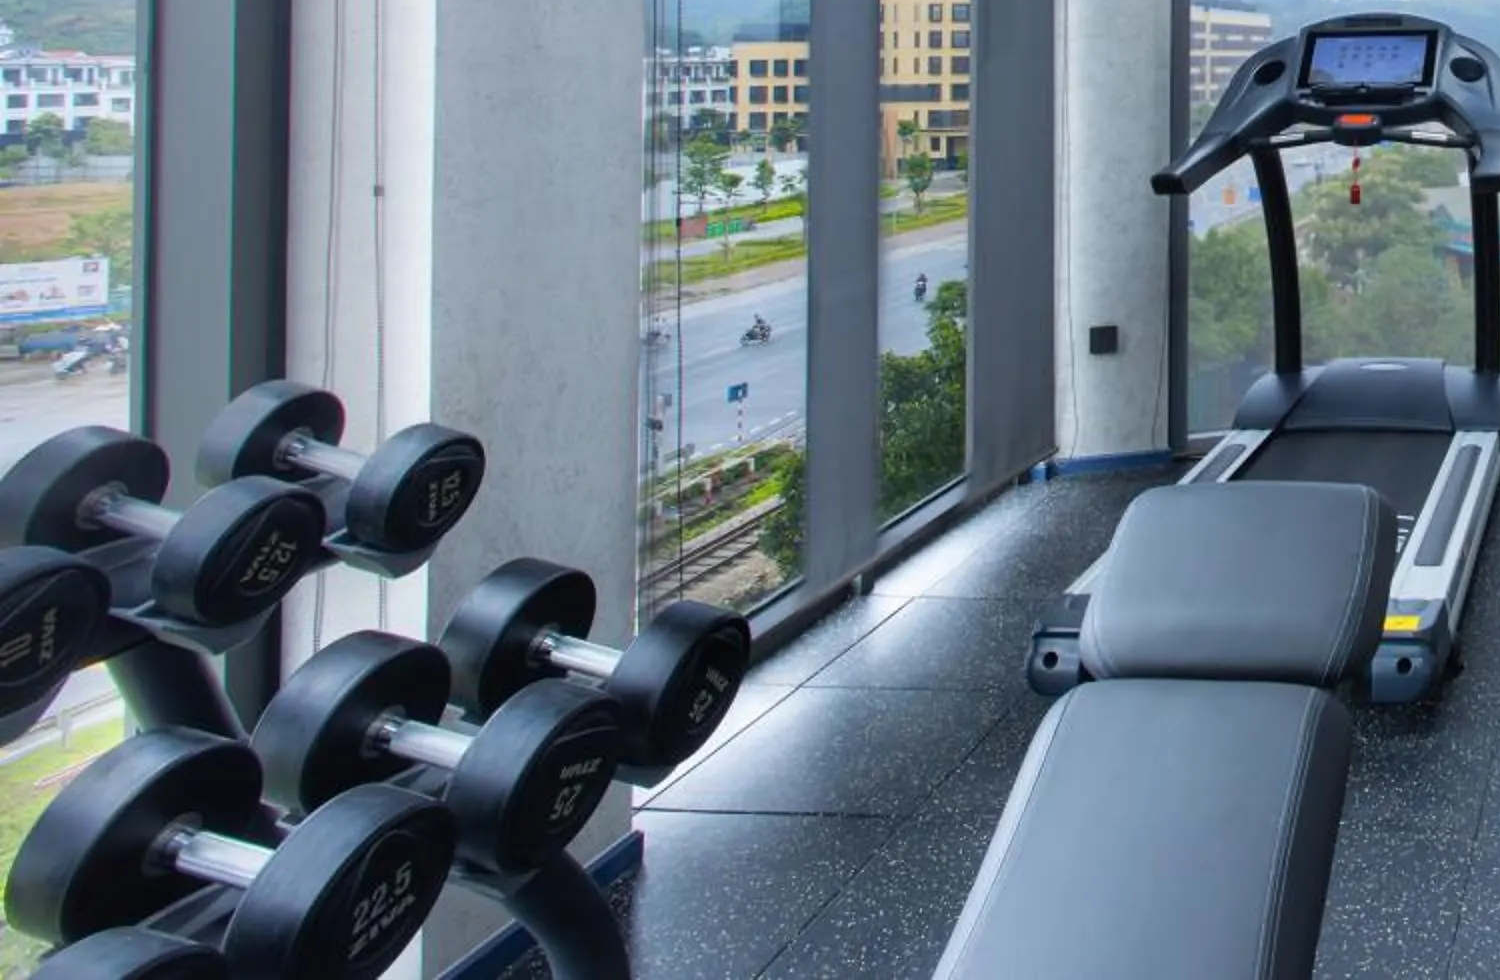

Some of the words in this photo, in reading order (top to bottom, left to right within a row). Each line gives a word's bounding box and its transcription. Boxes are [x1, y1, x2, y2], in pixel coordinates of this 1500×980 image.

[257, 540, 297, 582] 12.5
[38, 606, 58, 665] ZIVA
[549, 784, 582, 820] 25
[347, 894, 416, 960] ZIVA
[352, 861, 412, 936] 22.5
